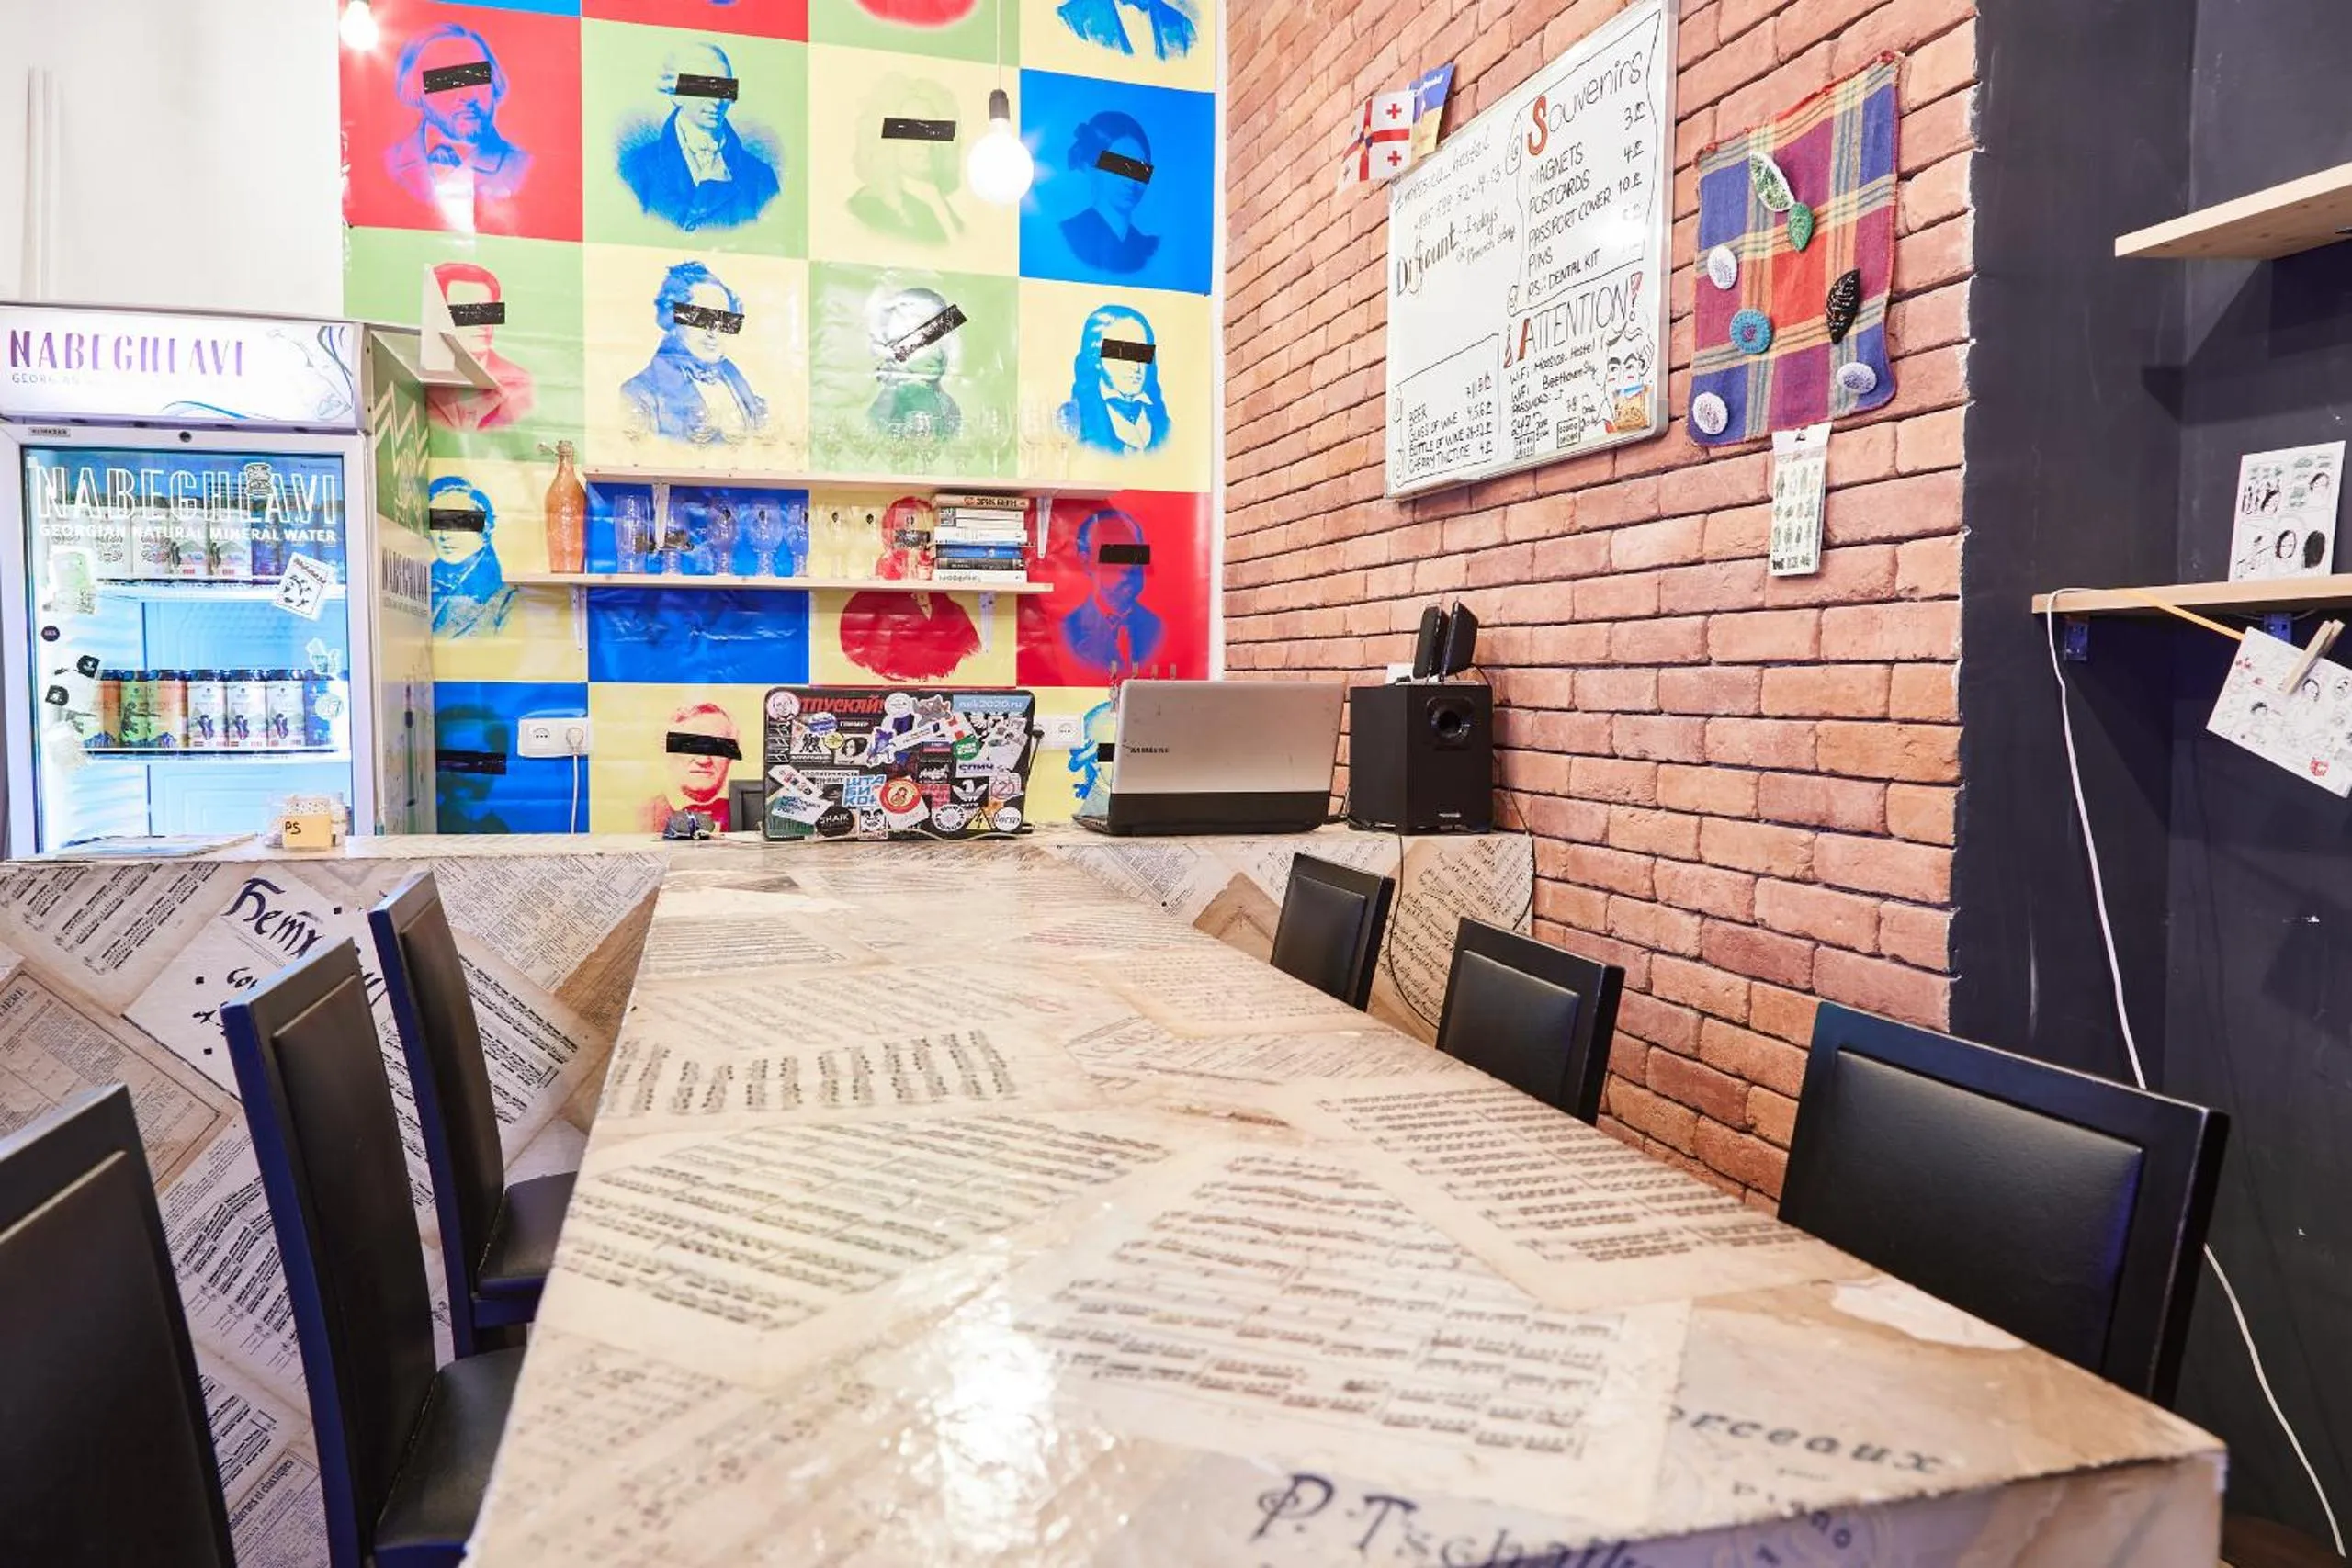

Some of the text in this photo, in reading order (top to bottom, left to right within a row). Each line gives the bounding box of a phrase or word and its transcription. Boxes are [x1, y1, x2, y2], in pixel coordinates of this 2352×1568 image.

[1527, 51, 1644, 156] Souvenirs
[1529, 141, 1584, 185] MAGNETS
[1529, 208, 1577, 250] PASSPORT
[1578, 187, 1611, 221] COVER
[1529, 246, 1554, 277] PINS
[1549, 259, 1581, 290] DENTAL
[1584, 247, 1600, 268] KIT
[40, 525, 336, 543] GEORGIAN NATURAL MINERAL WATER
[283, 821, 301, 835] PS
